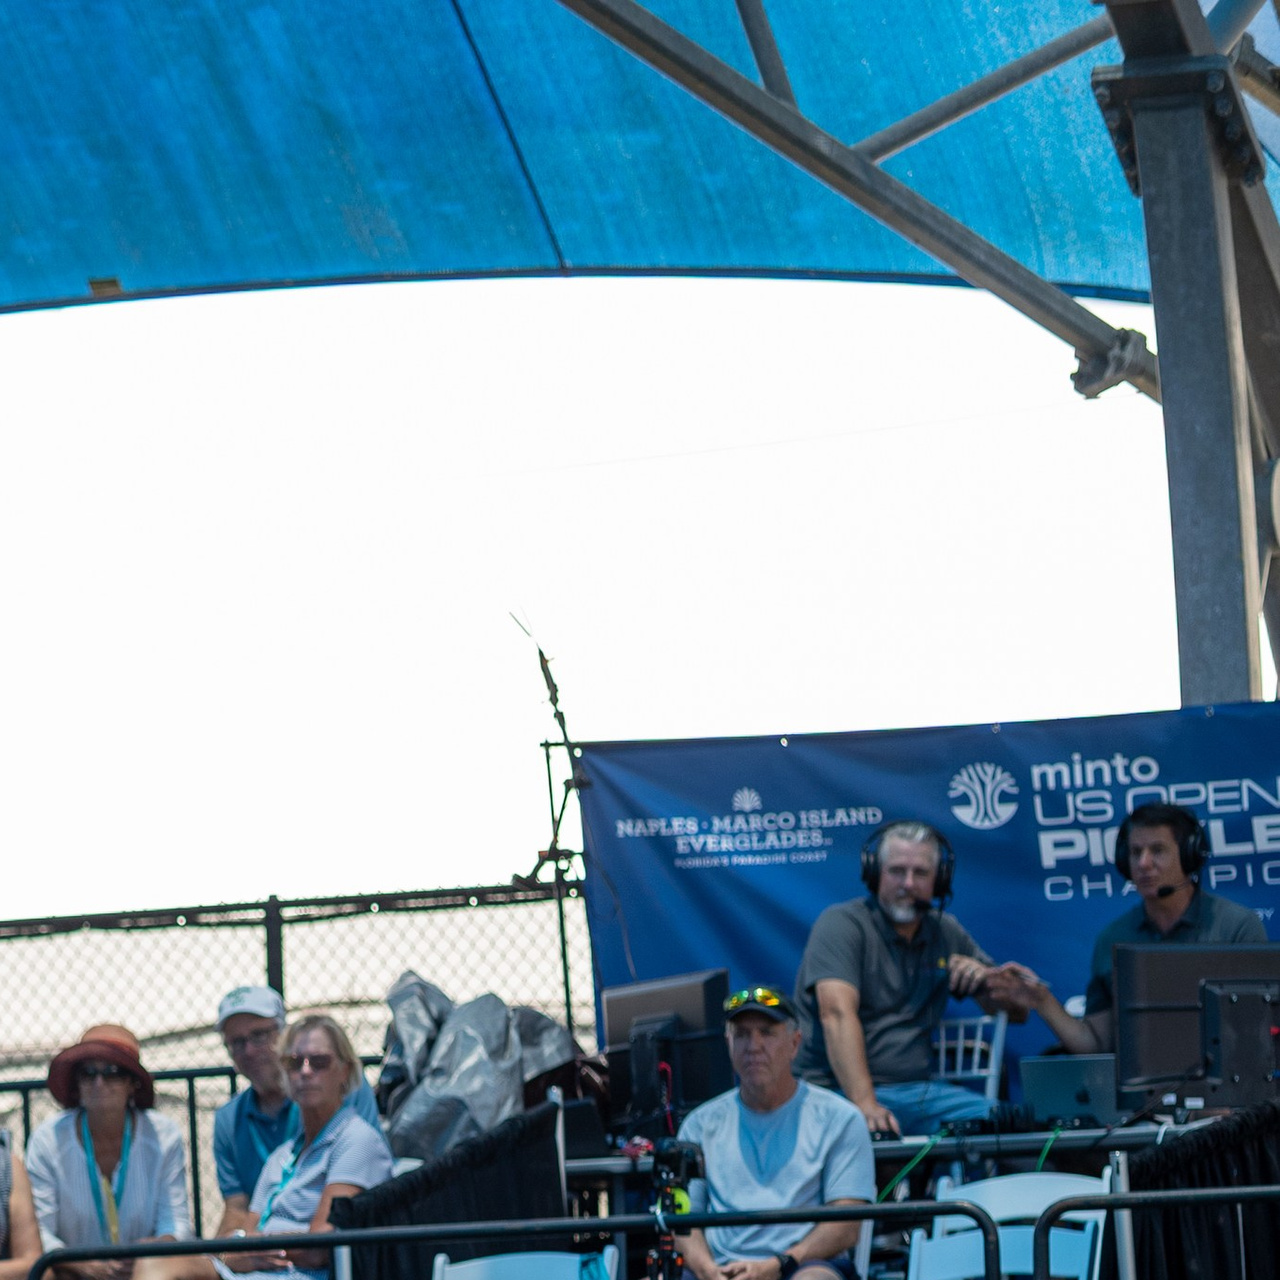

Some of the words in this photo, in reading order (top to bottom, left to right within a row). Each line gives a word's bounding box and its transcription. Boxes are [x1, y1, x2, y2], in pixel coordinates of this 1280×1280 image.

[1030, 752, 1160, 792] minto
[615, 816, 699, 838] NAPLES
[710, 811, 796, 833] MARCO
[798, 806, 884, 828] ISLAND
[1033, 788, 1115, 826] US
[675, 829, 823, 854] EVERGLADES
